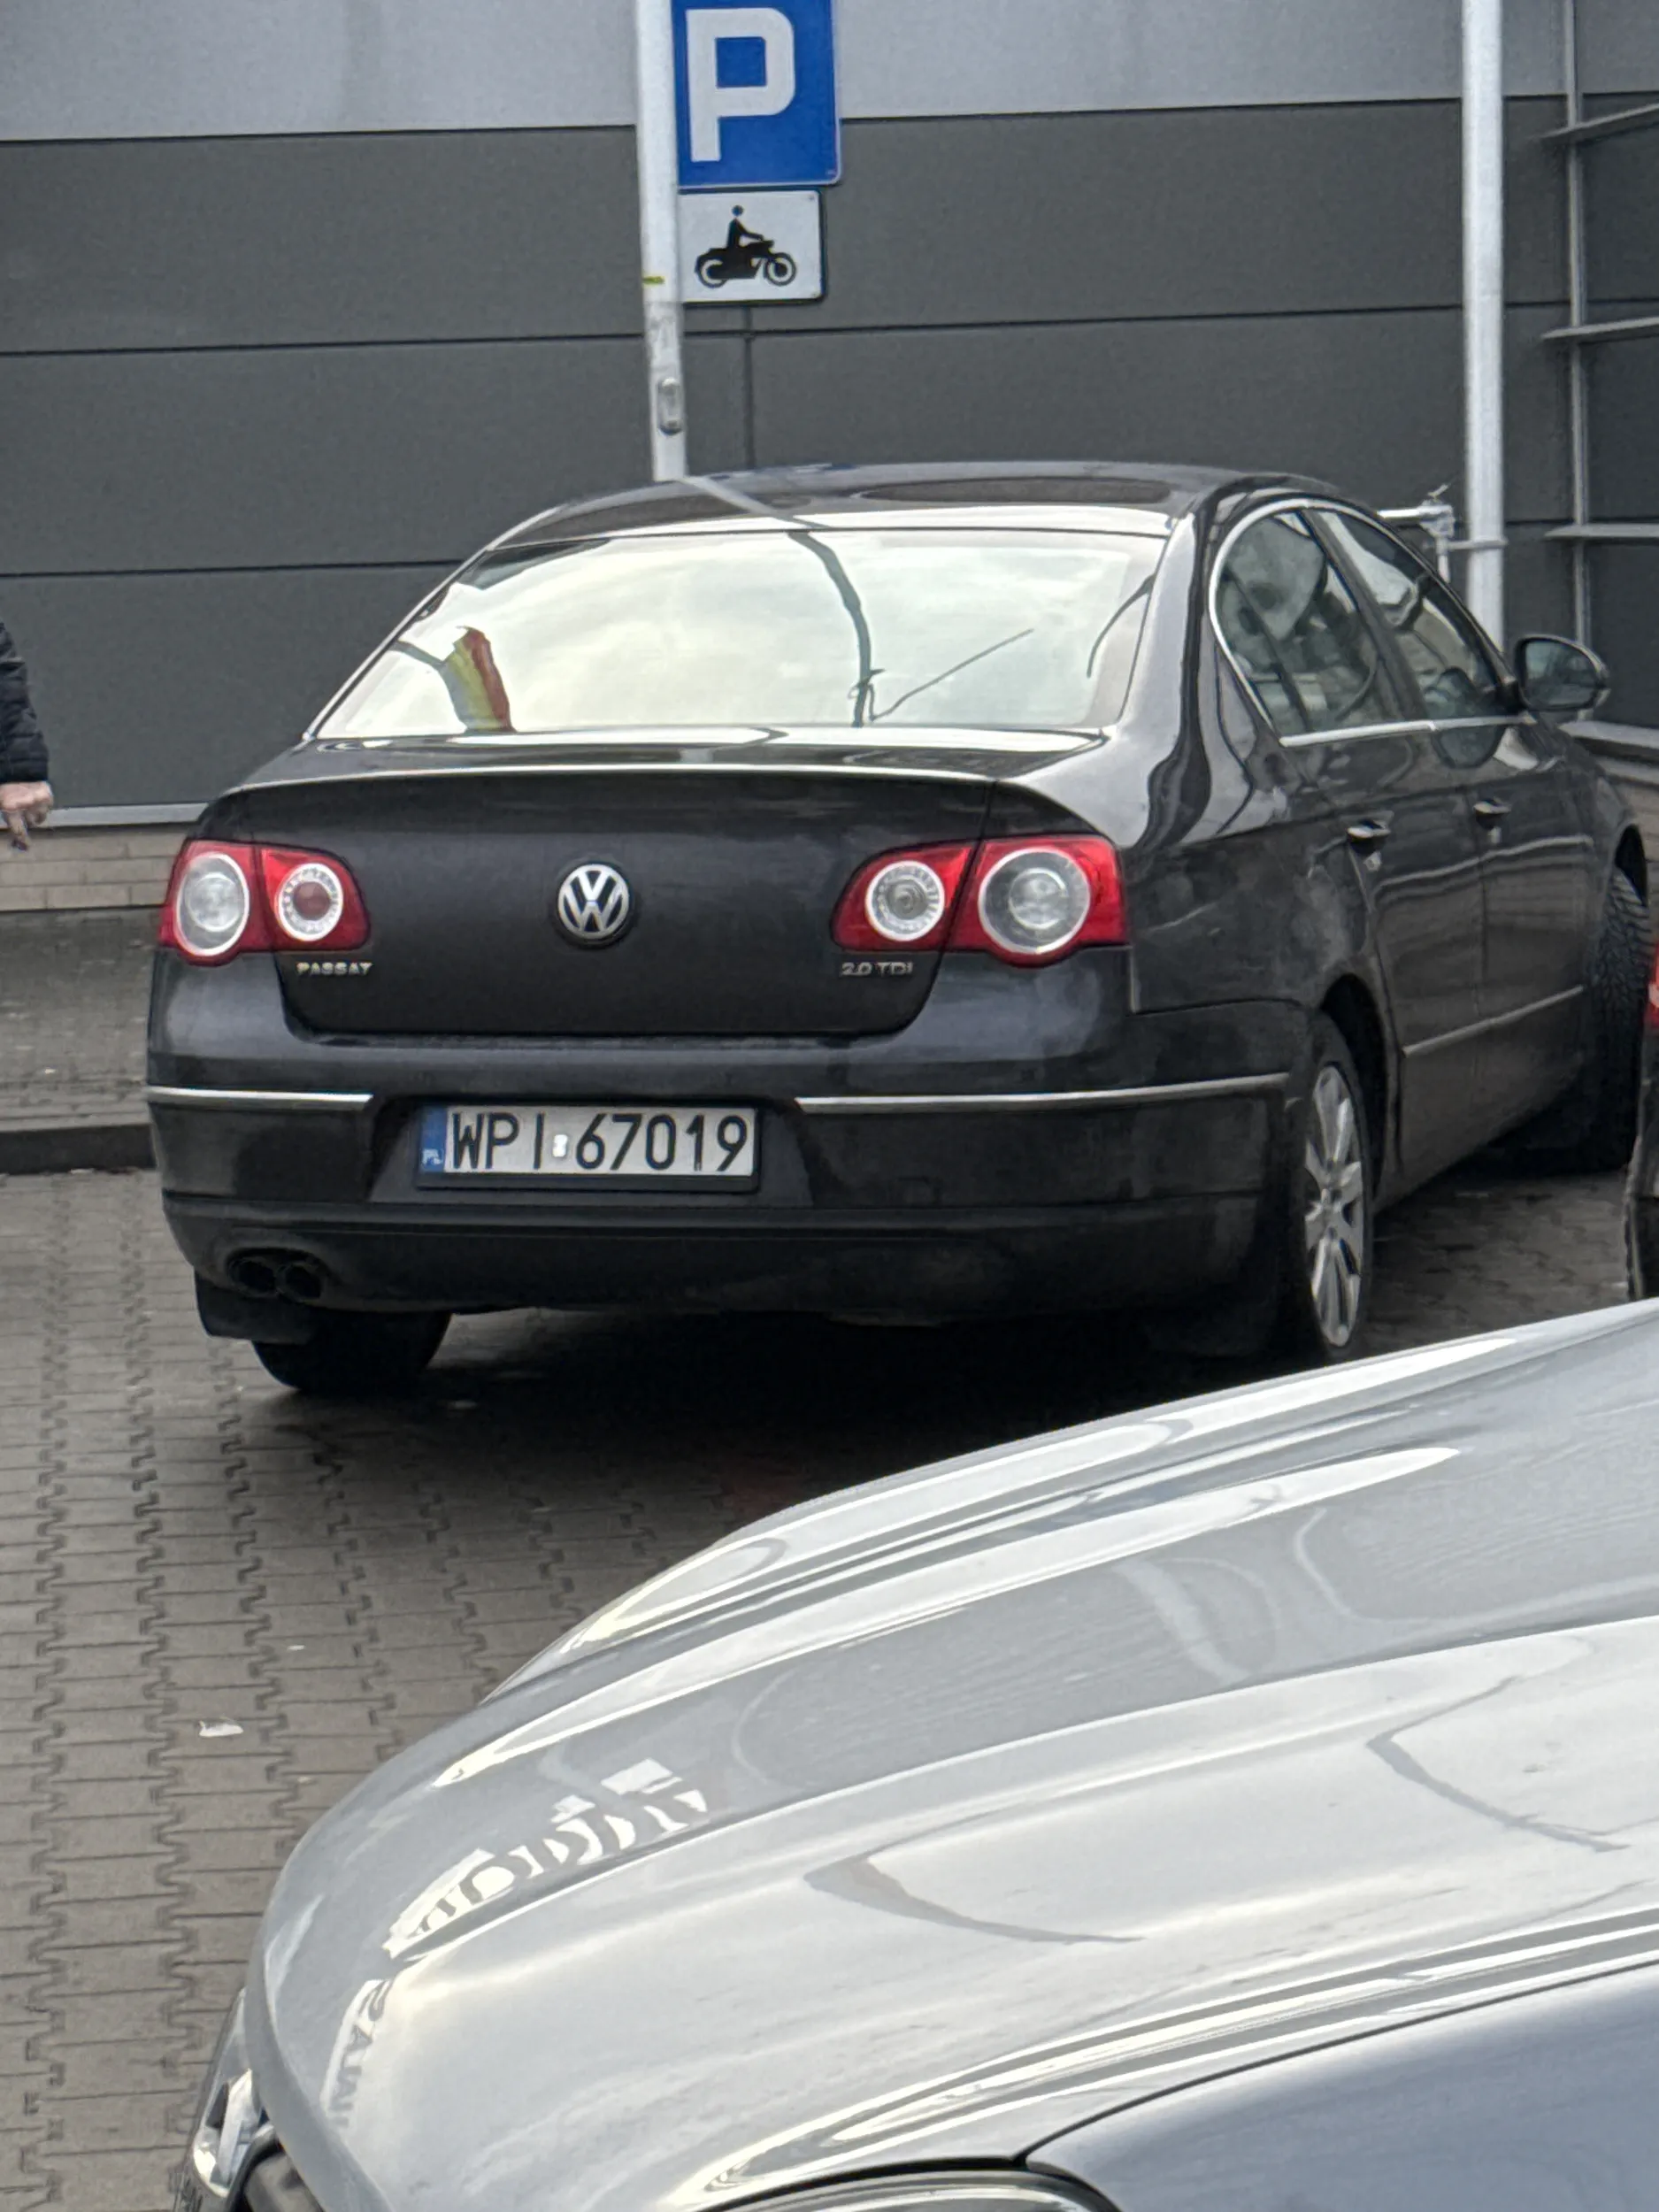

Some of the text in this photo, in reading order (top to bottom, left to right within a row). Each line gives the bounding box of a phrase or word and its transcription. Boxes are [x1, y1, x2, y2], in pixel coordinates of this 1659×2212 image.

[686, 7, 795, 162] P
[876, 962, 914, 976] TDI
[453, 1111, 748, 1172] WPI 67019
